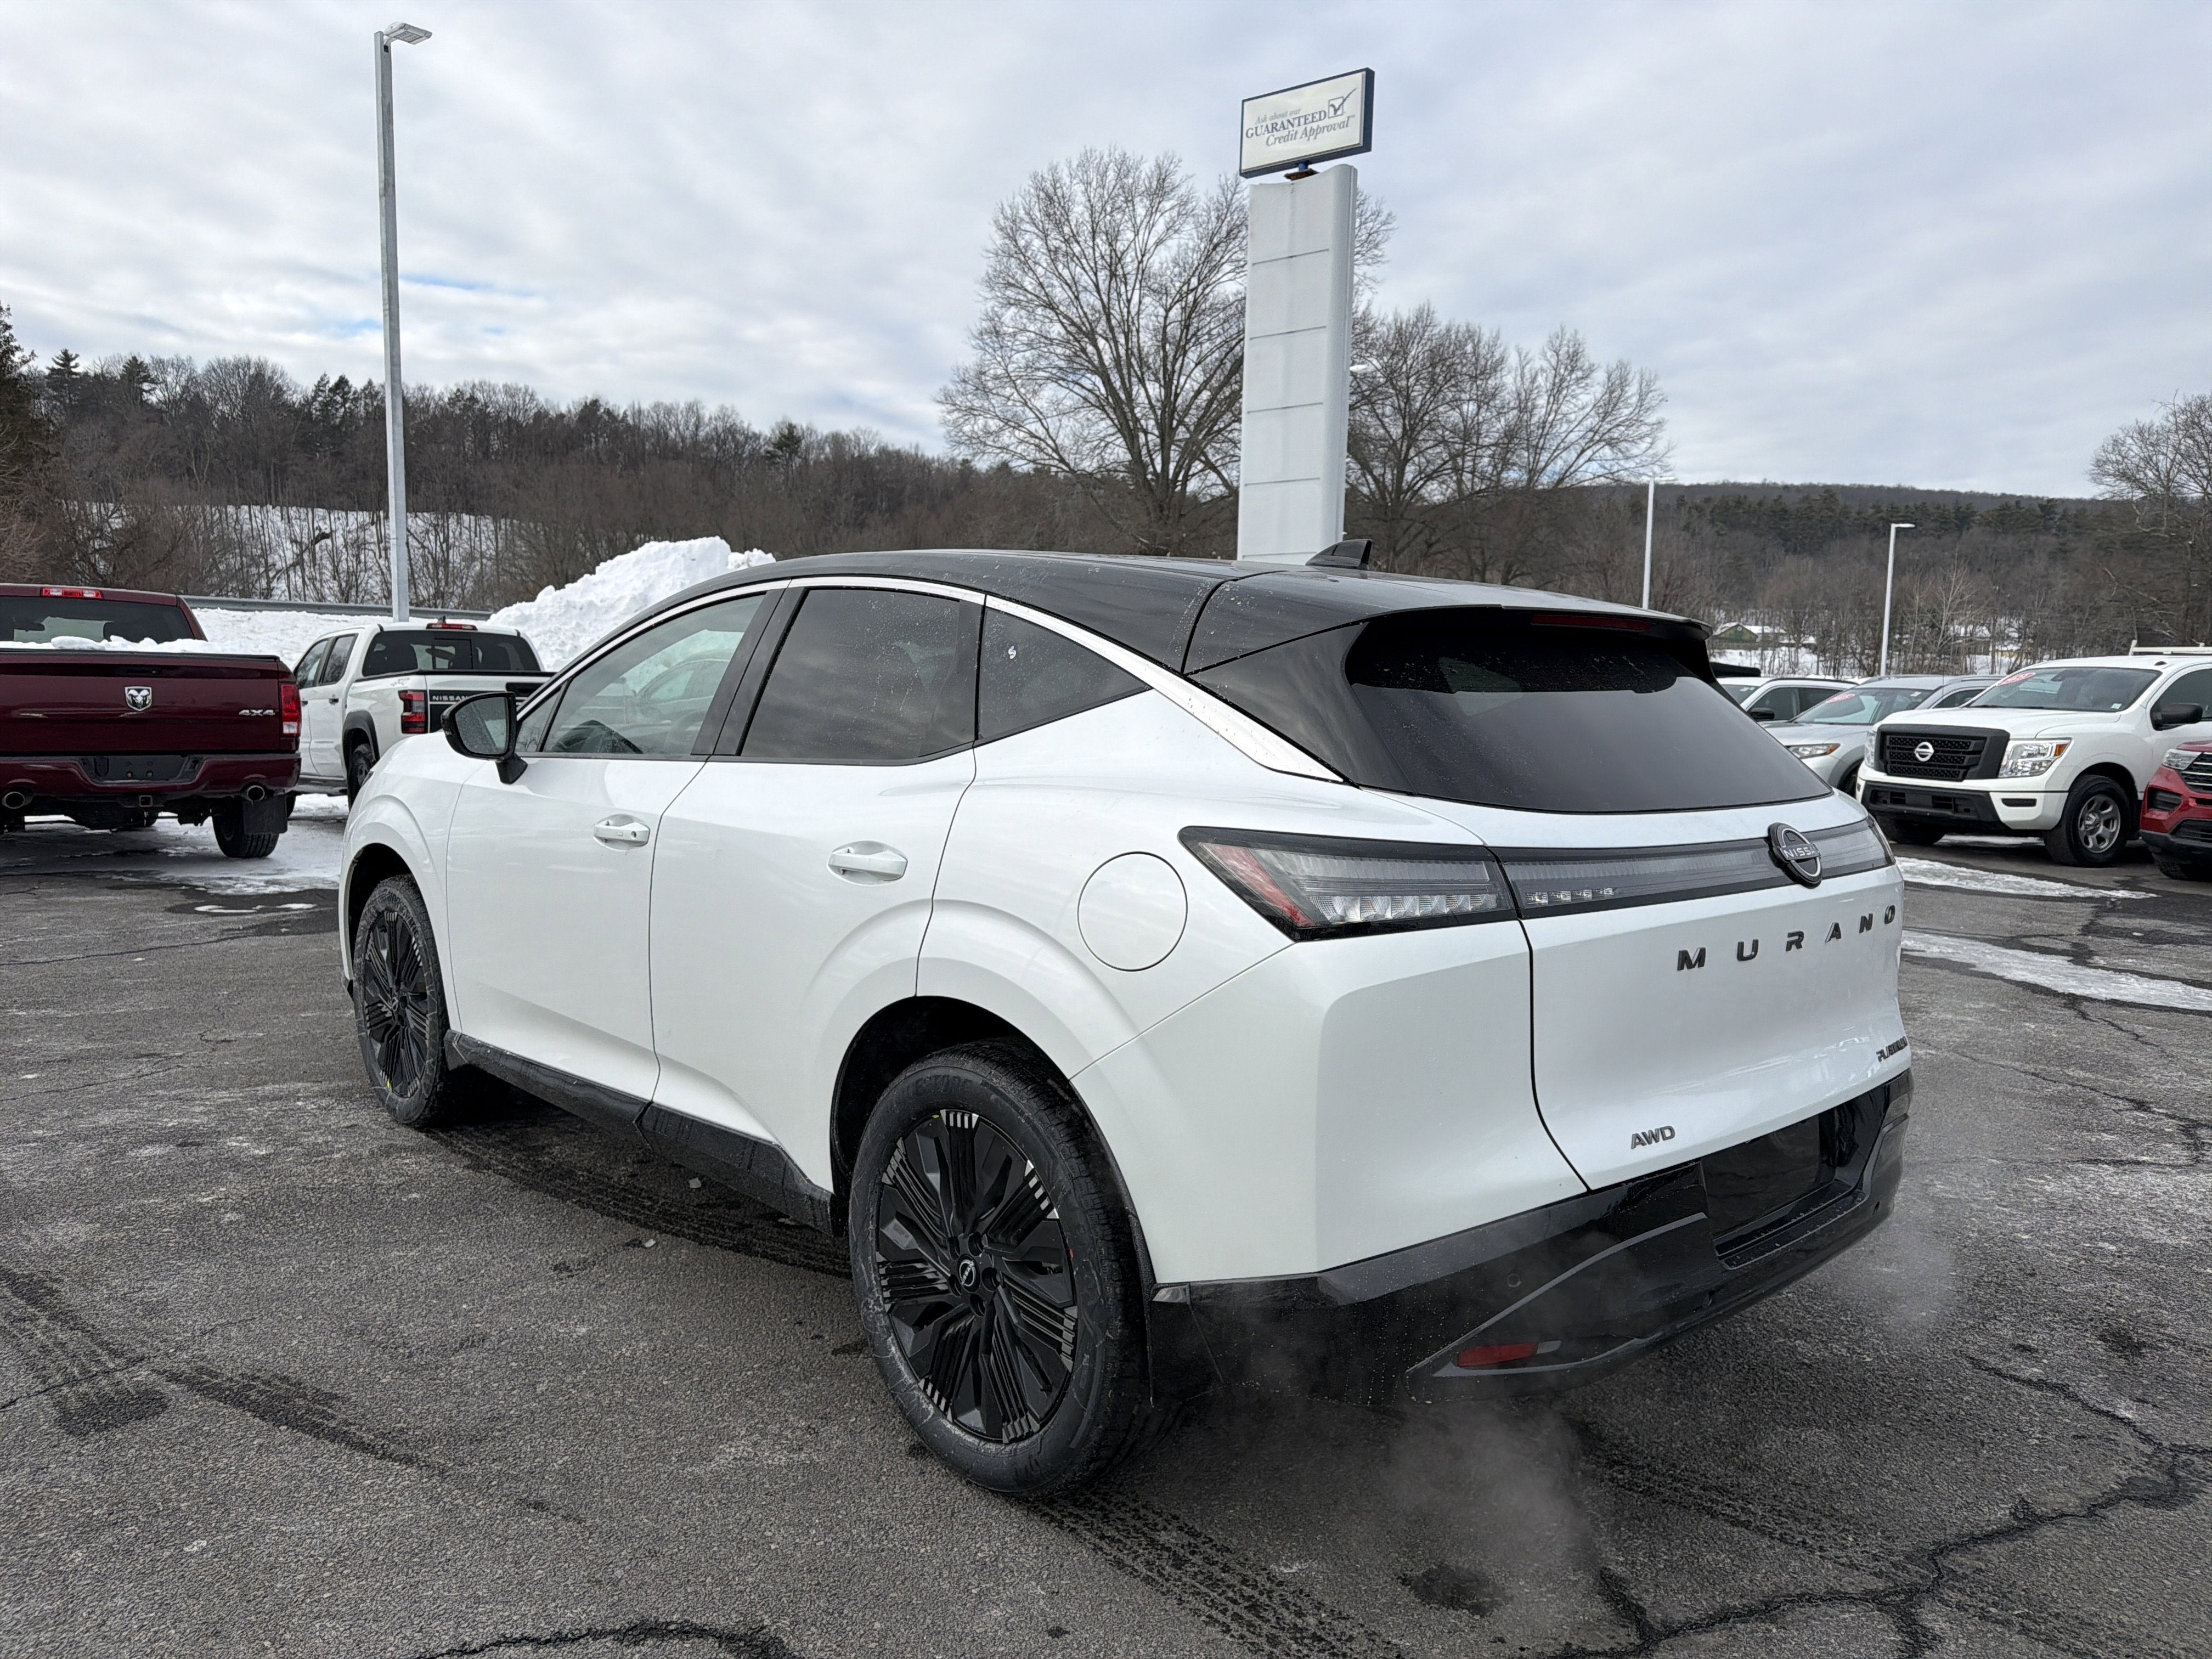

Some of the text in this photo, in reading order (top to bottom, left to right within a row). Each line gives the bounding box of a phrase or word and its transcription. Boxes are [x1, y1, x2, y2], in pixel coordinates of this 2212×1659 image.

[1245, 110, 1327, 138] GUARANTEED
[1255, 116, 1268, 125] Ask
[1269, 111, 1288, 120] about
[1266, 116, 1351, 146] Credit Approval
[1677, 905, 1895, 971] MURANO
[1630, 1125, 1675, 1150] AWD
